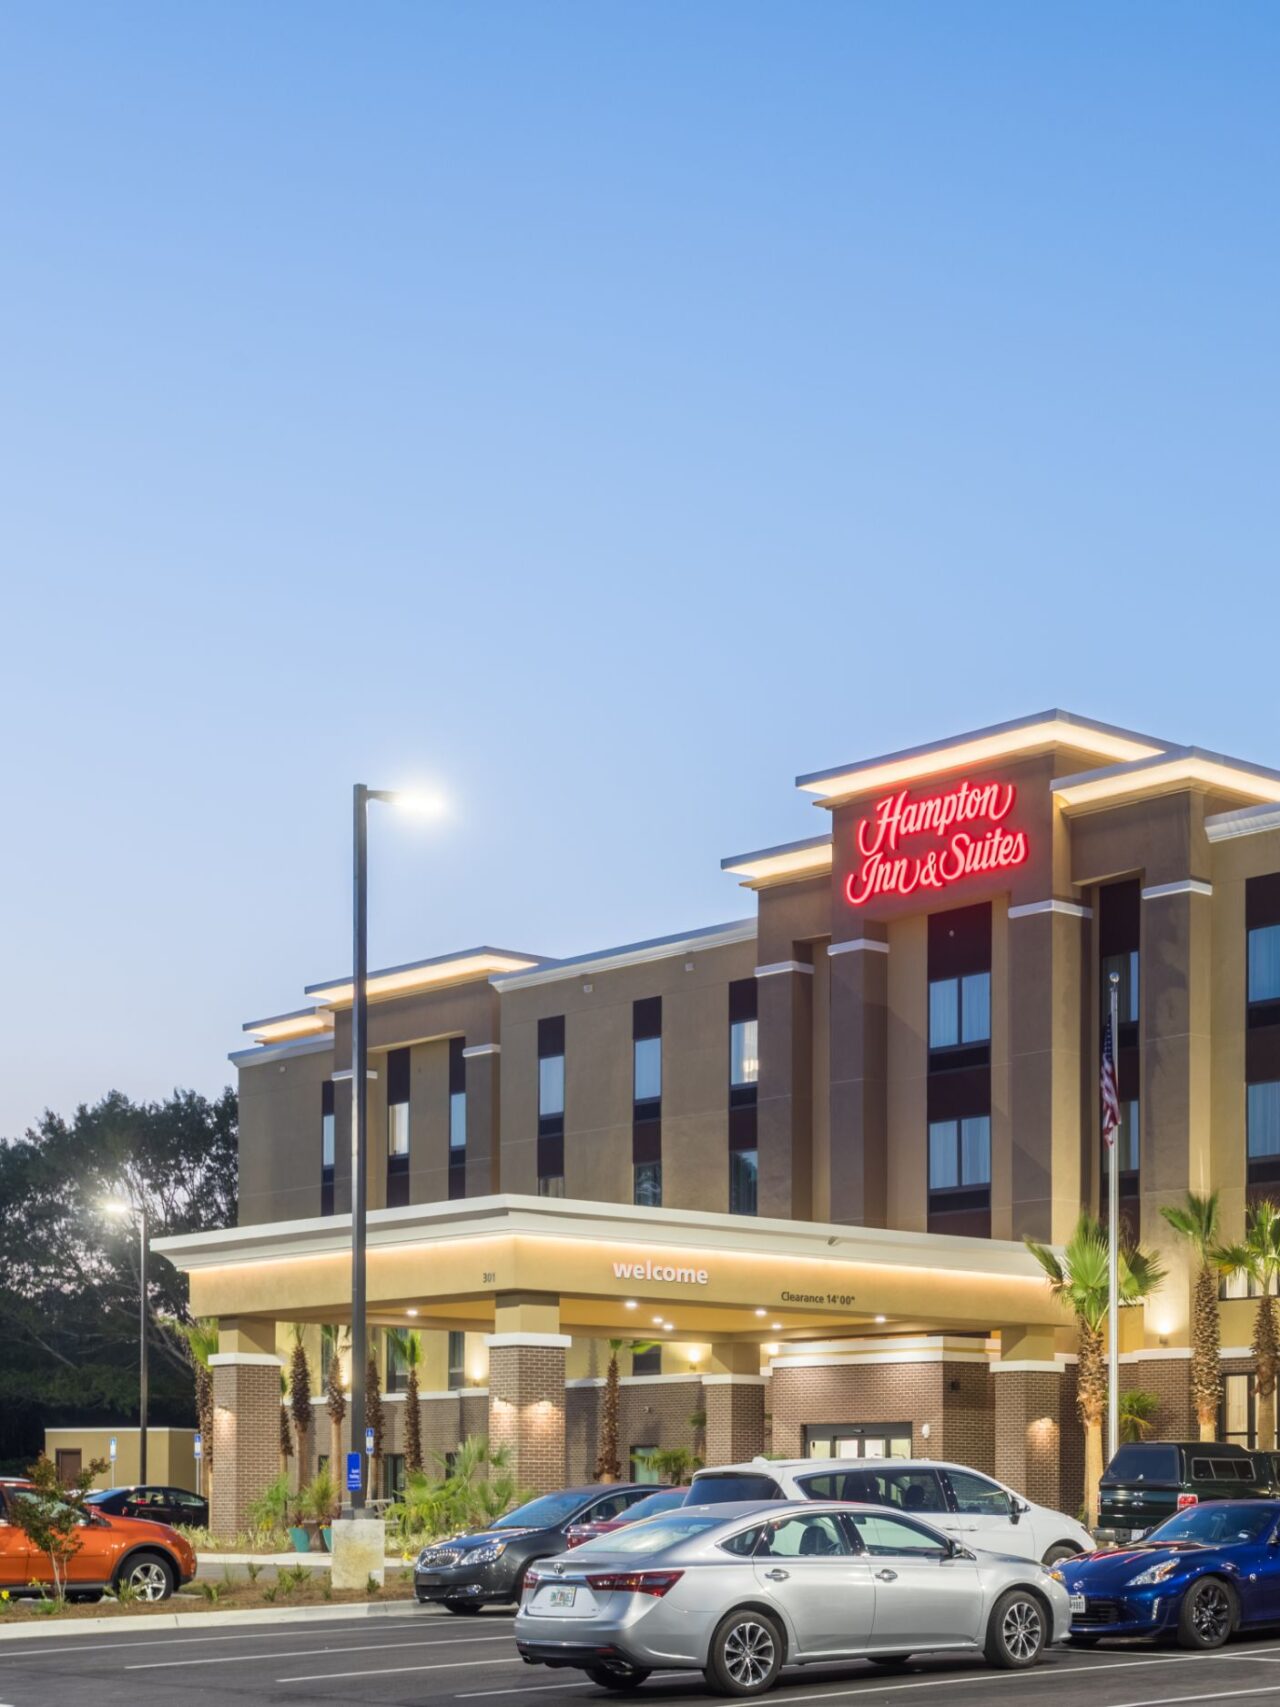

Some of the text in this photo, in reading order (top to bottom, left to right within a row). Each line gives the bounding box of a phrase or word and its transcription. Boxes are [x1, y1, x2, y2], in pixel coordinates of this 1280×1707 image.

[858, 781, 1014, 857] Hampton
[846, 828, 1027, 904] Inn & Suites
[483, 1272, 496, 1284] 301
[612, 1259, 709, 1286] welcome
[780, 1291, 825, 1304] Clearance
